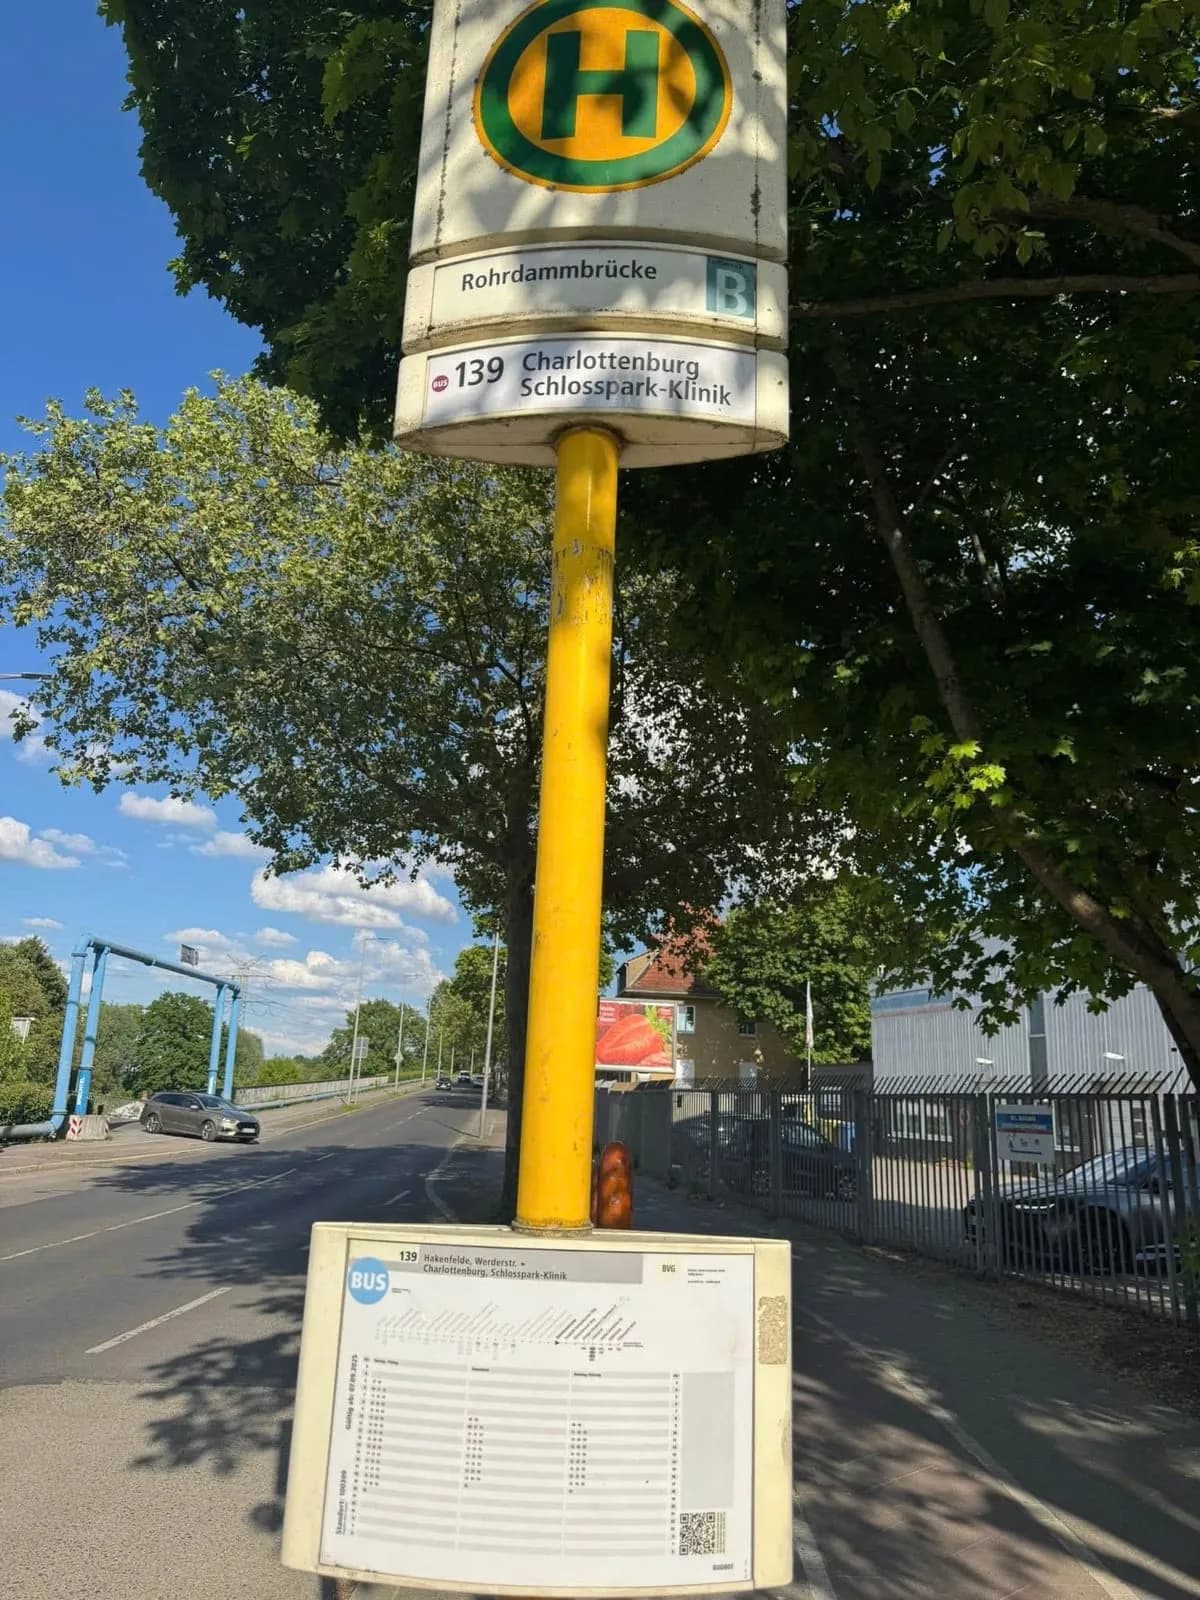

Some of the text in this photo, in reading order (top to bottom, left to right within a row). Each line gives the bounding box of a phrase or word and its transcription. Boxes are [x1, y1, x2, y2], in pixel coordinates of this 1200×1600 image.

[540, 30, 660, 140] H
[461, 259, 657, 291] Rohrdammbrücke
[716, 268, 748, 315] B
[455, 356, 505, 388] 139
[522, 350, 700, 380] Charlottenburg
[520, 376, 732, 406] Schlosspark-Klinik
[400, 1251, 418, 1262] 139
[424, 1254, 518, 1268] Hakenfelde, Werderstr.
[661, 1264, 676, 1273] BVG
[350, 1271, 387, 1291] BUS
[423, 1264, 568, 1281] Charlottenburg, Schlosspark-Klinik
